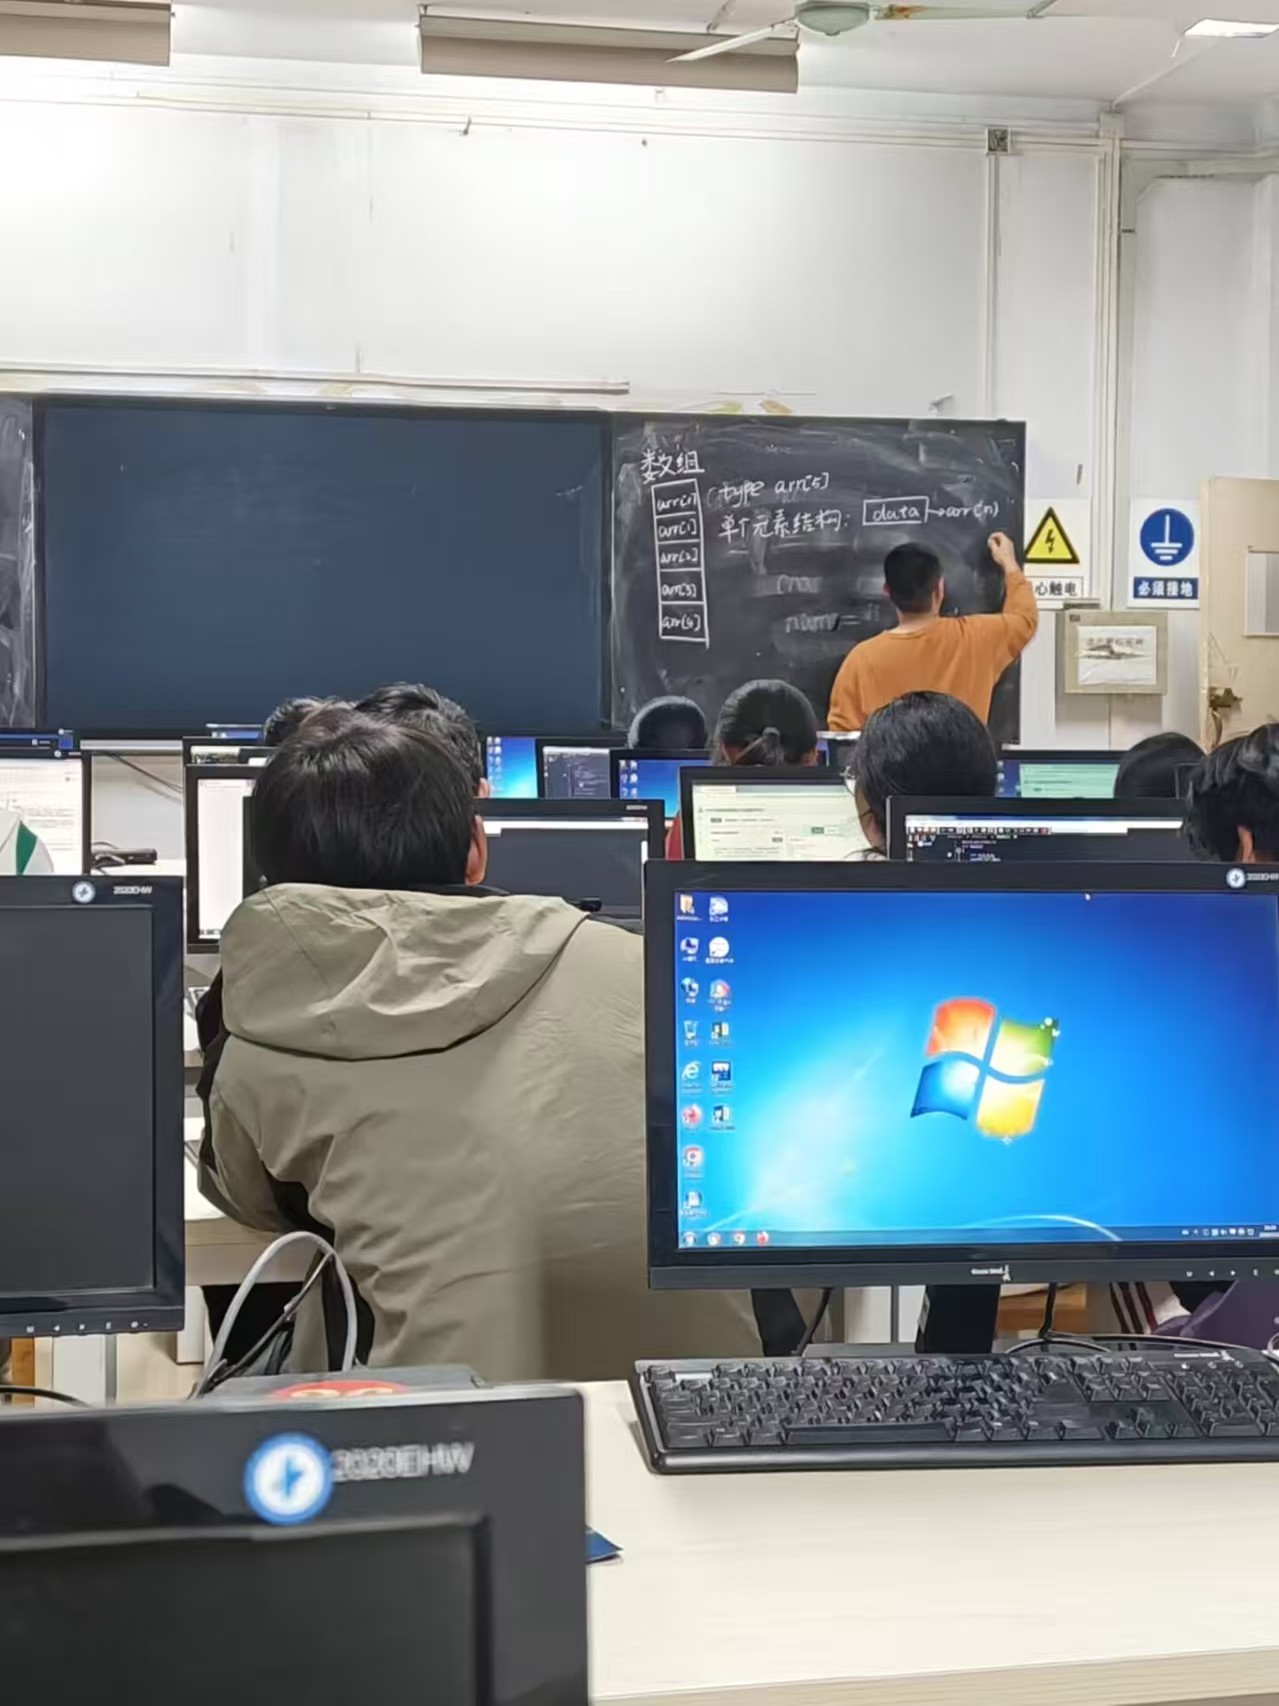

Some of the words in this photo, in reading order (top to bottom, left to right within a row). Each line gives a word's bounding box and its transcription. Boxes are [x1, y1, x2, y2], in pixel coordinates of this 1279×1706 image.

[640, 449, 705, 485] 数组
[872, 503, 920, 521] data
[1034, 581, 1078, 597] 心触电
